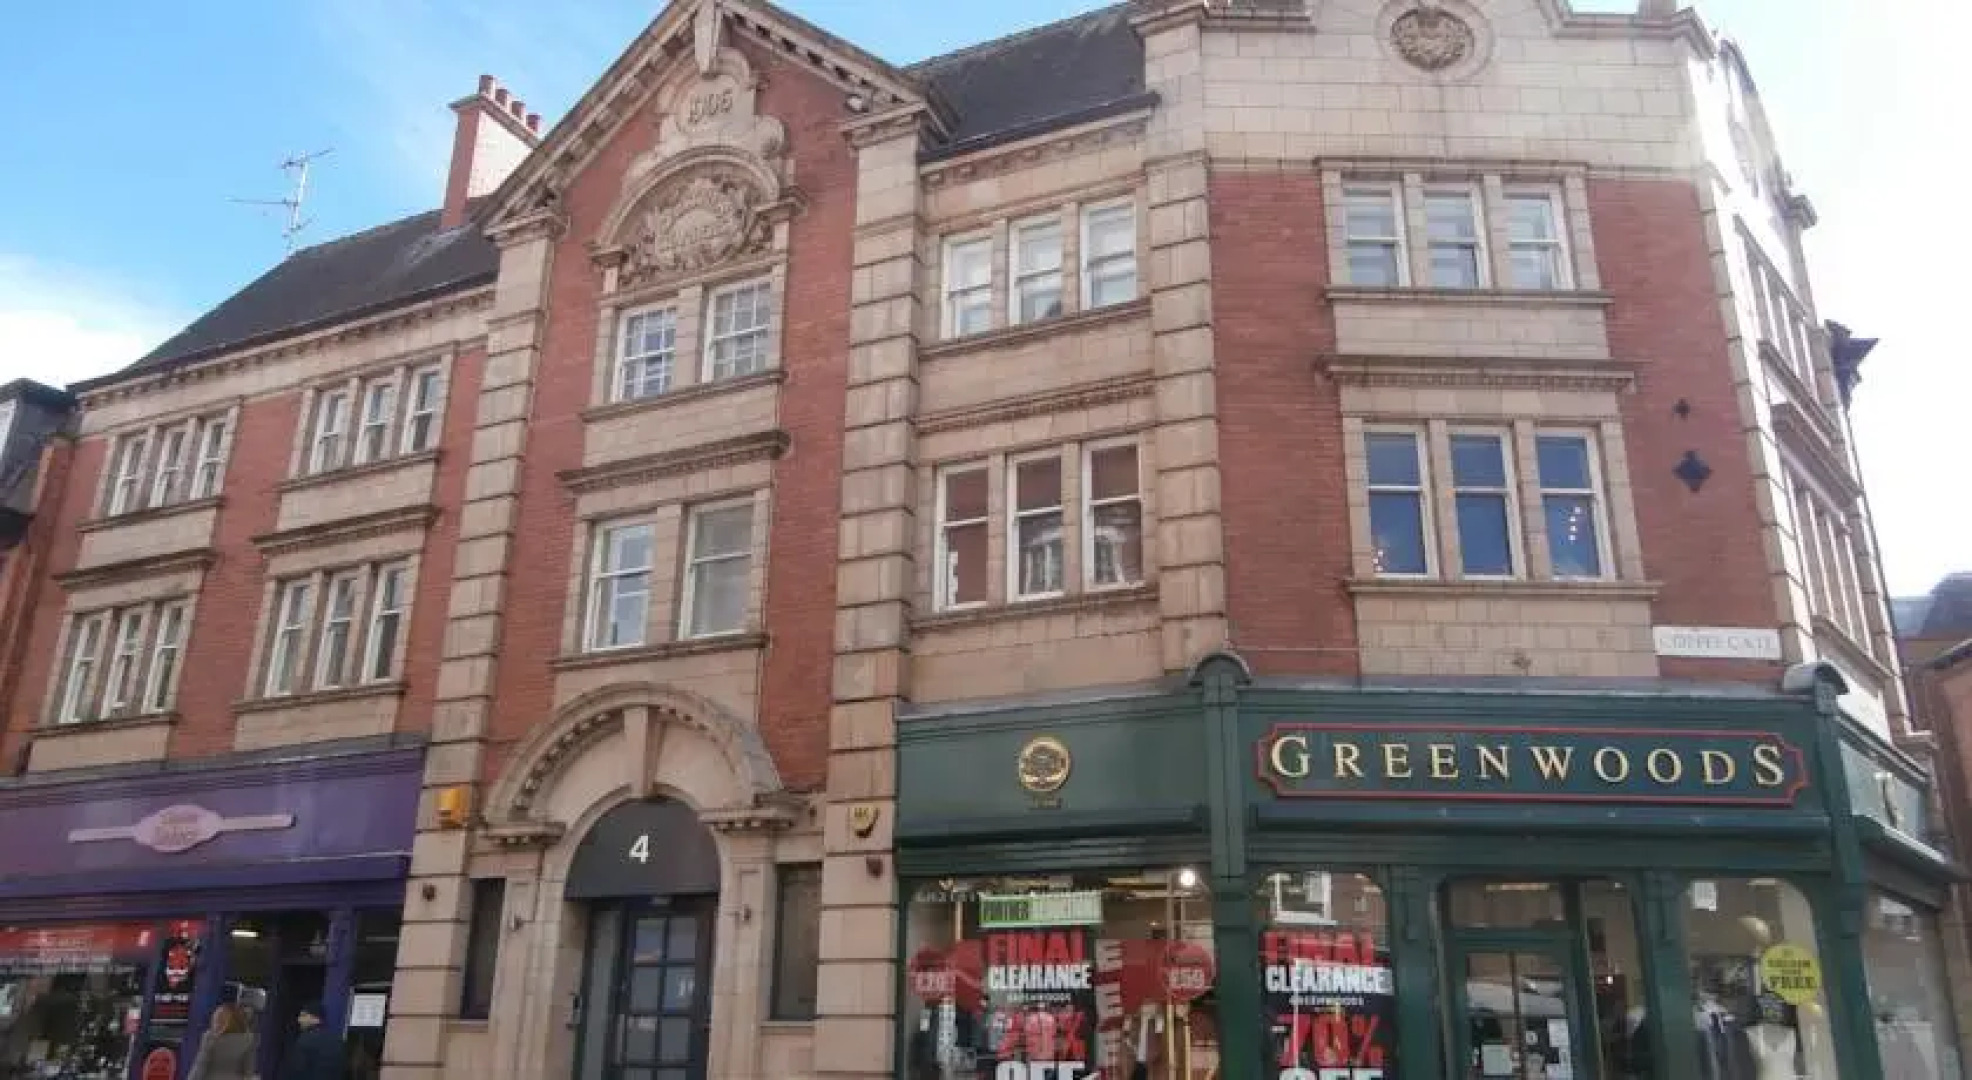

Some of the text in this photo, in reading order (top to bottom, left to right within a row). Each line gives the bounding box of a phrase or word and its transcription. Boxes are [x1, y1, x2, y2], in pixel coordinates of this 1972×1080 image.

[1271, 736, 1786, 787] GREENWOODS
[628, 834, 649, 864] 4
[987, 930, 1085, 966] FINAL
[1264, 930, 1374, 966] FINAL
[988, 964, 1092, 989] CLEARANCE
[1266, 966, 1393, 994] CLEARANCE
[1276, 1014, 1385, 1067] 70%
